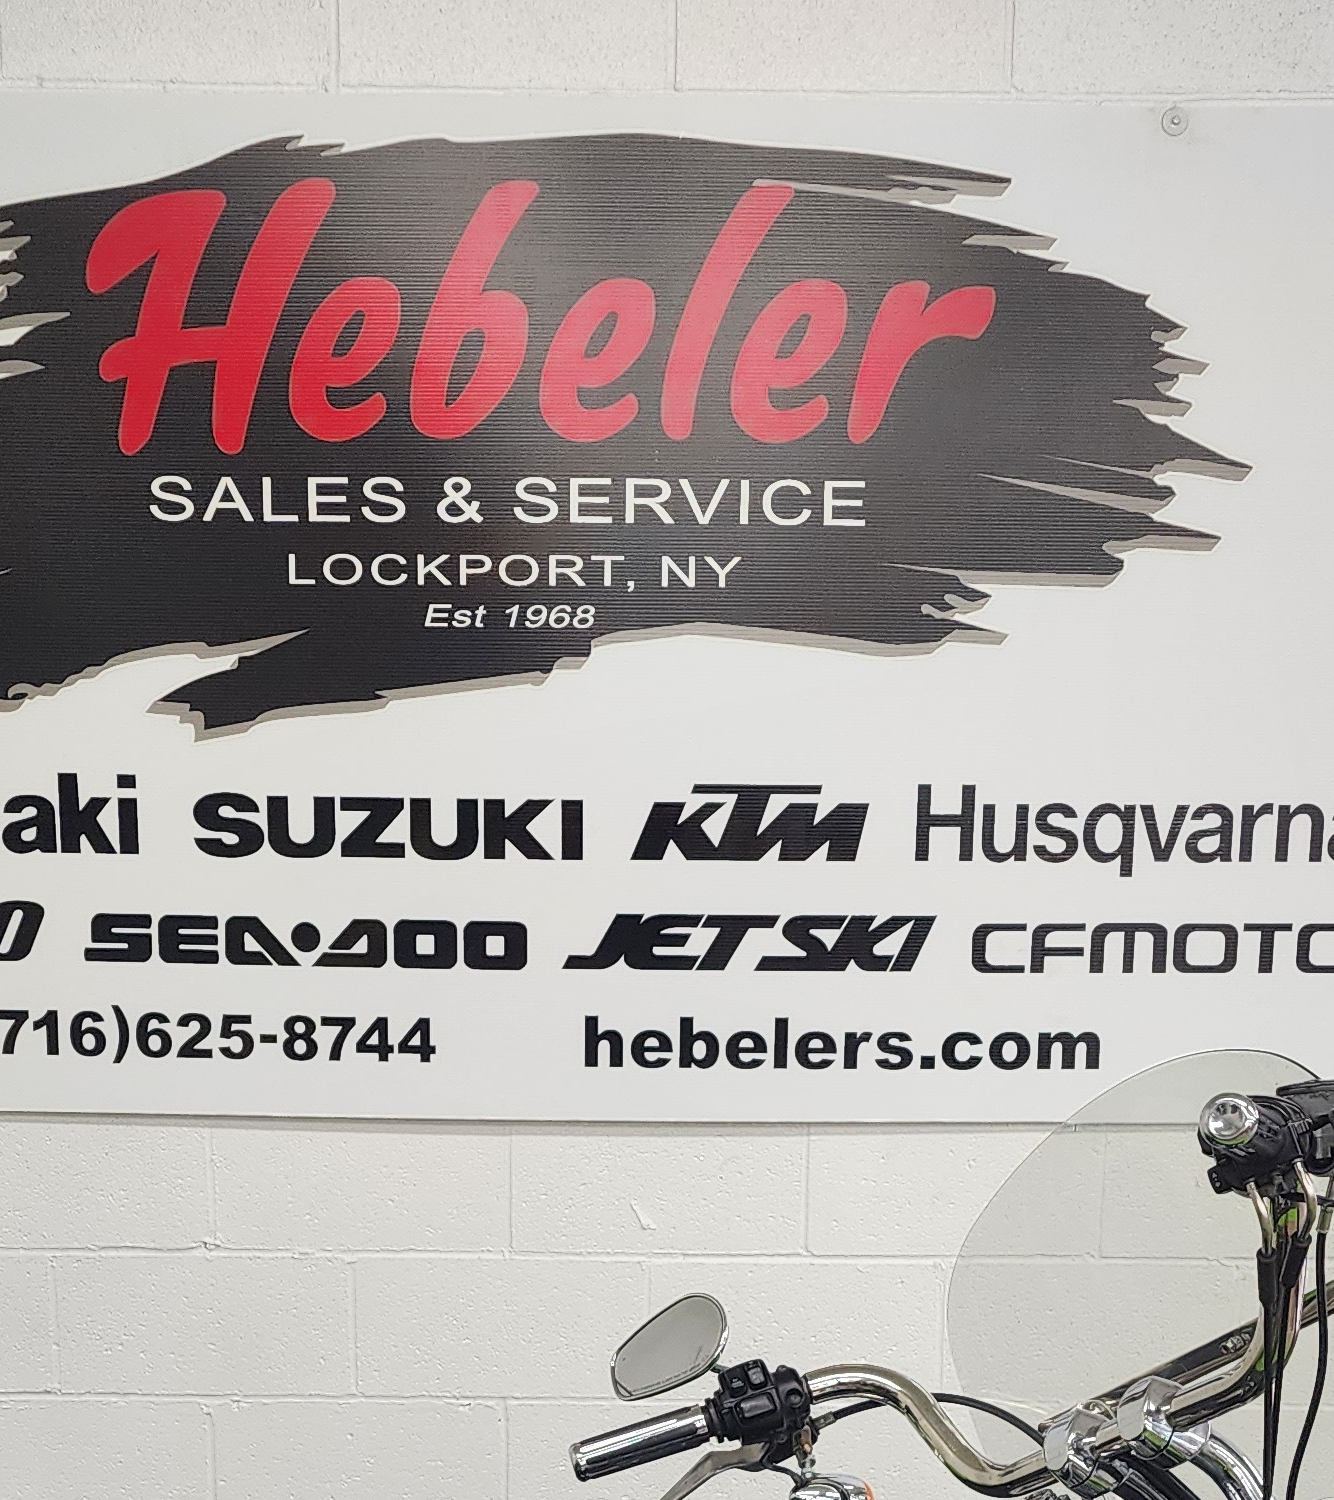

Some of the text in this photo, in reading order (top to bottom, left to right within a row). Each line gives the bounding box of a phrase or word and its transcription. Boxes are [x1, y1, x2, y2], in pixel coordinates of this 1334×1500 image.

[84, 177, 997, 456] Hebeler
[149, 475, 867, 527] SALES & SERVICE
[288, 553, 742, 592] LOCKPORT, NY
[424, 603, 596, 629] Est 1968
[192, 791, 584, 861] SUZUKI
[630, 783, 870, 862] KTM
[584, 1015, 1101, 1071] hebelers.com
